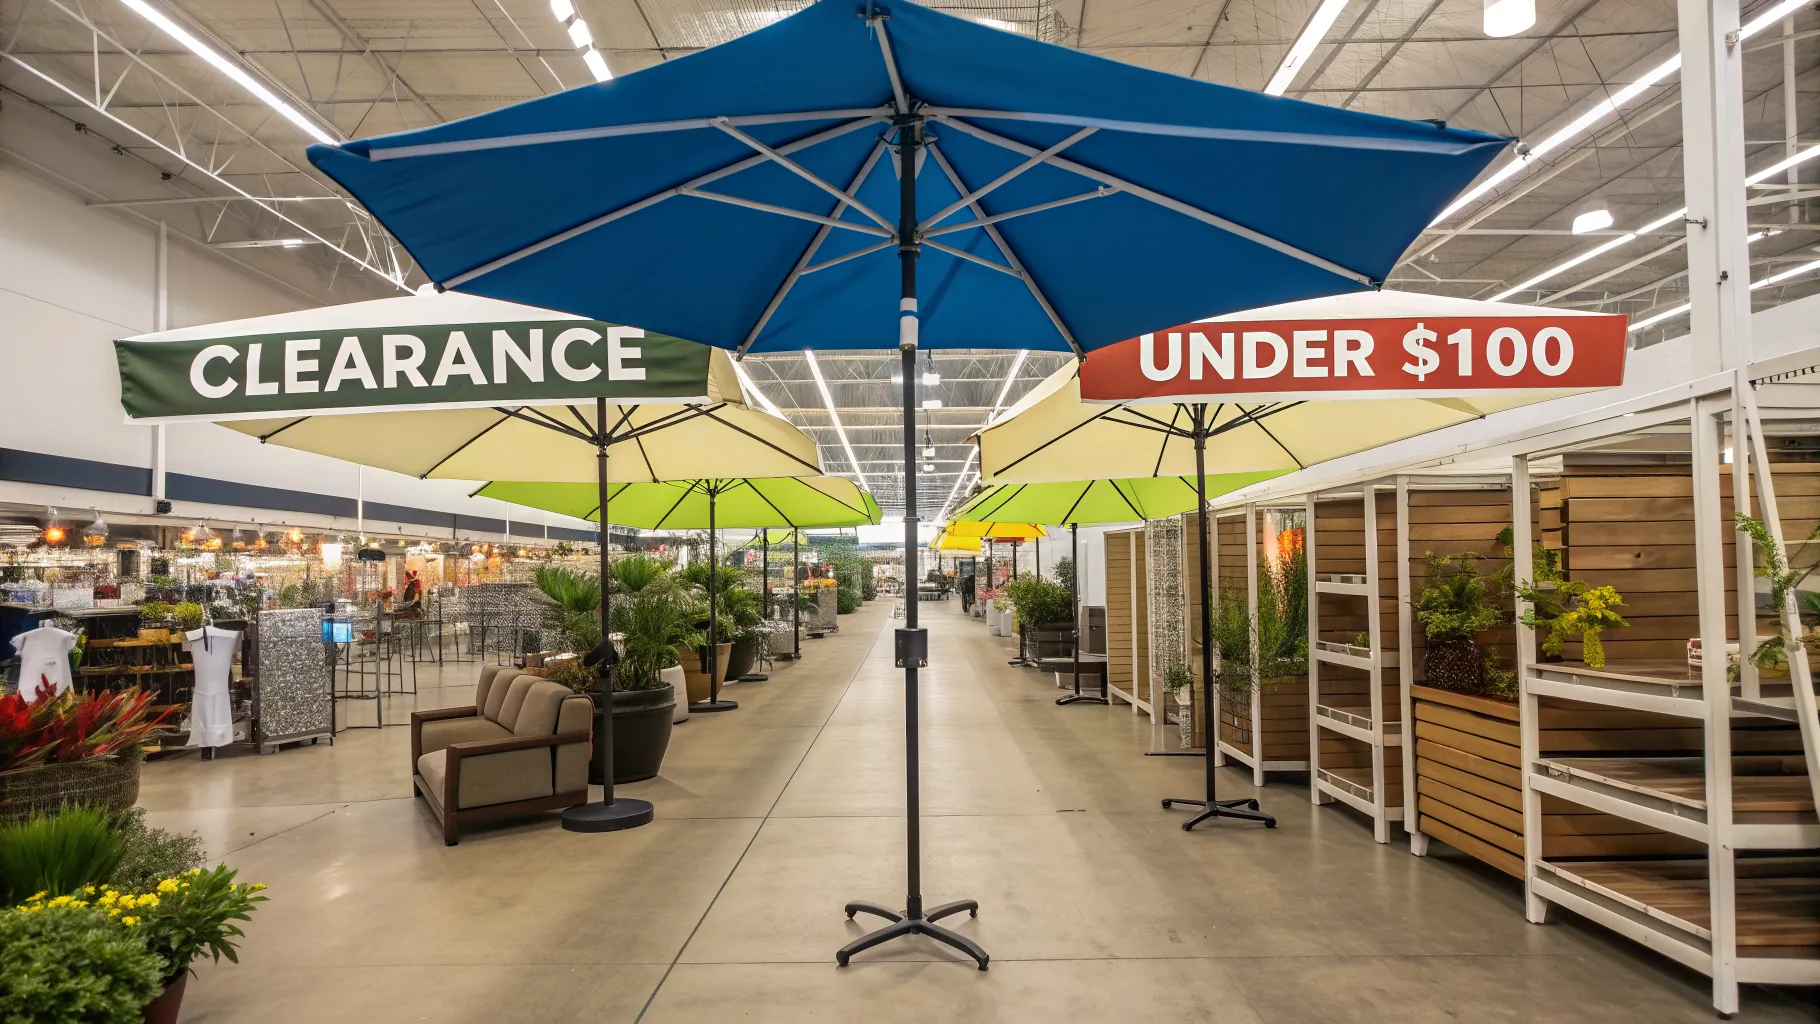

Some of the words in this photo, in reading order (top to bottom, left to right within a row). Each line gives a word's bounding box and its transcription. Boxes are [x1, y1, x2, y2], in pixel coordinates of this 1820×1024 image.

[189, 327, 647, 399] CLEARANCE
[1139, 330, 1376, 381] UNDER
[1401, 322, 1574, 382] $100
